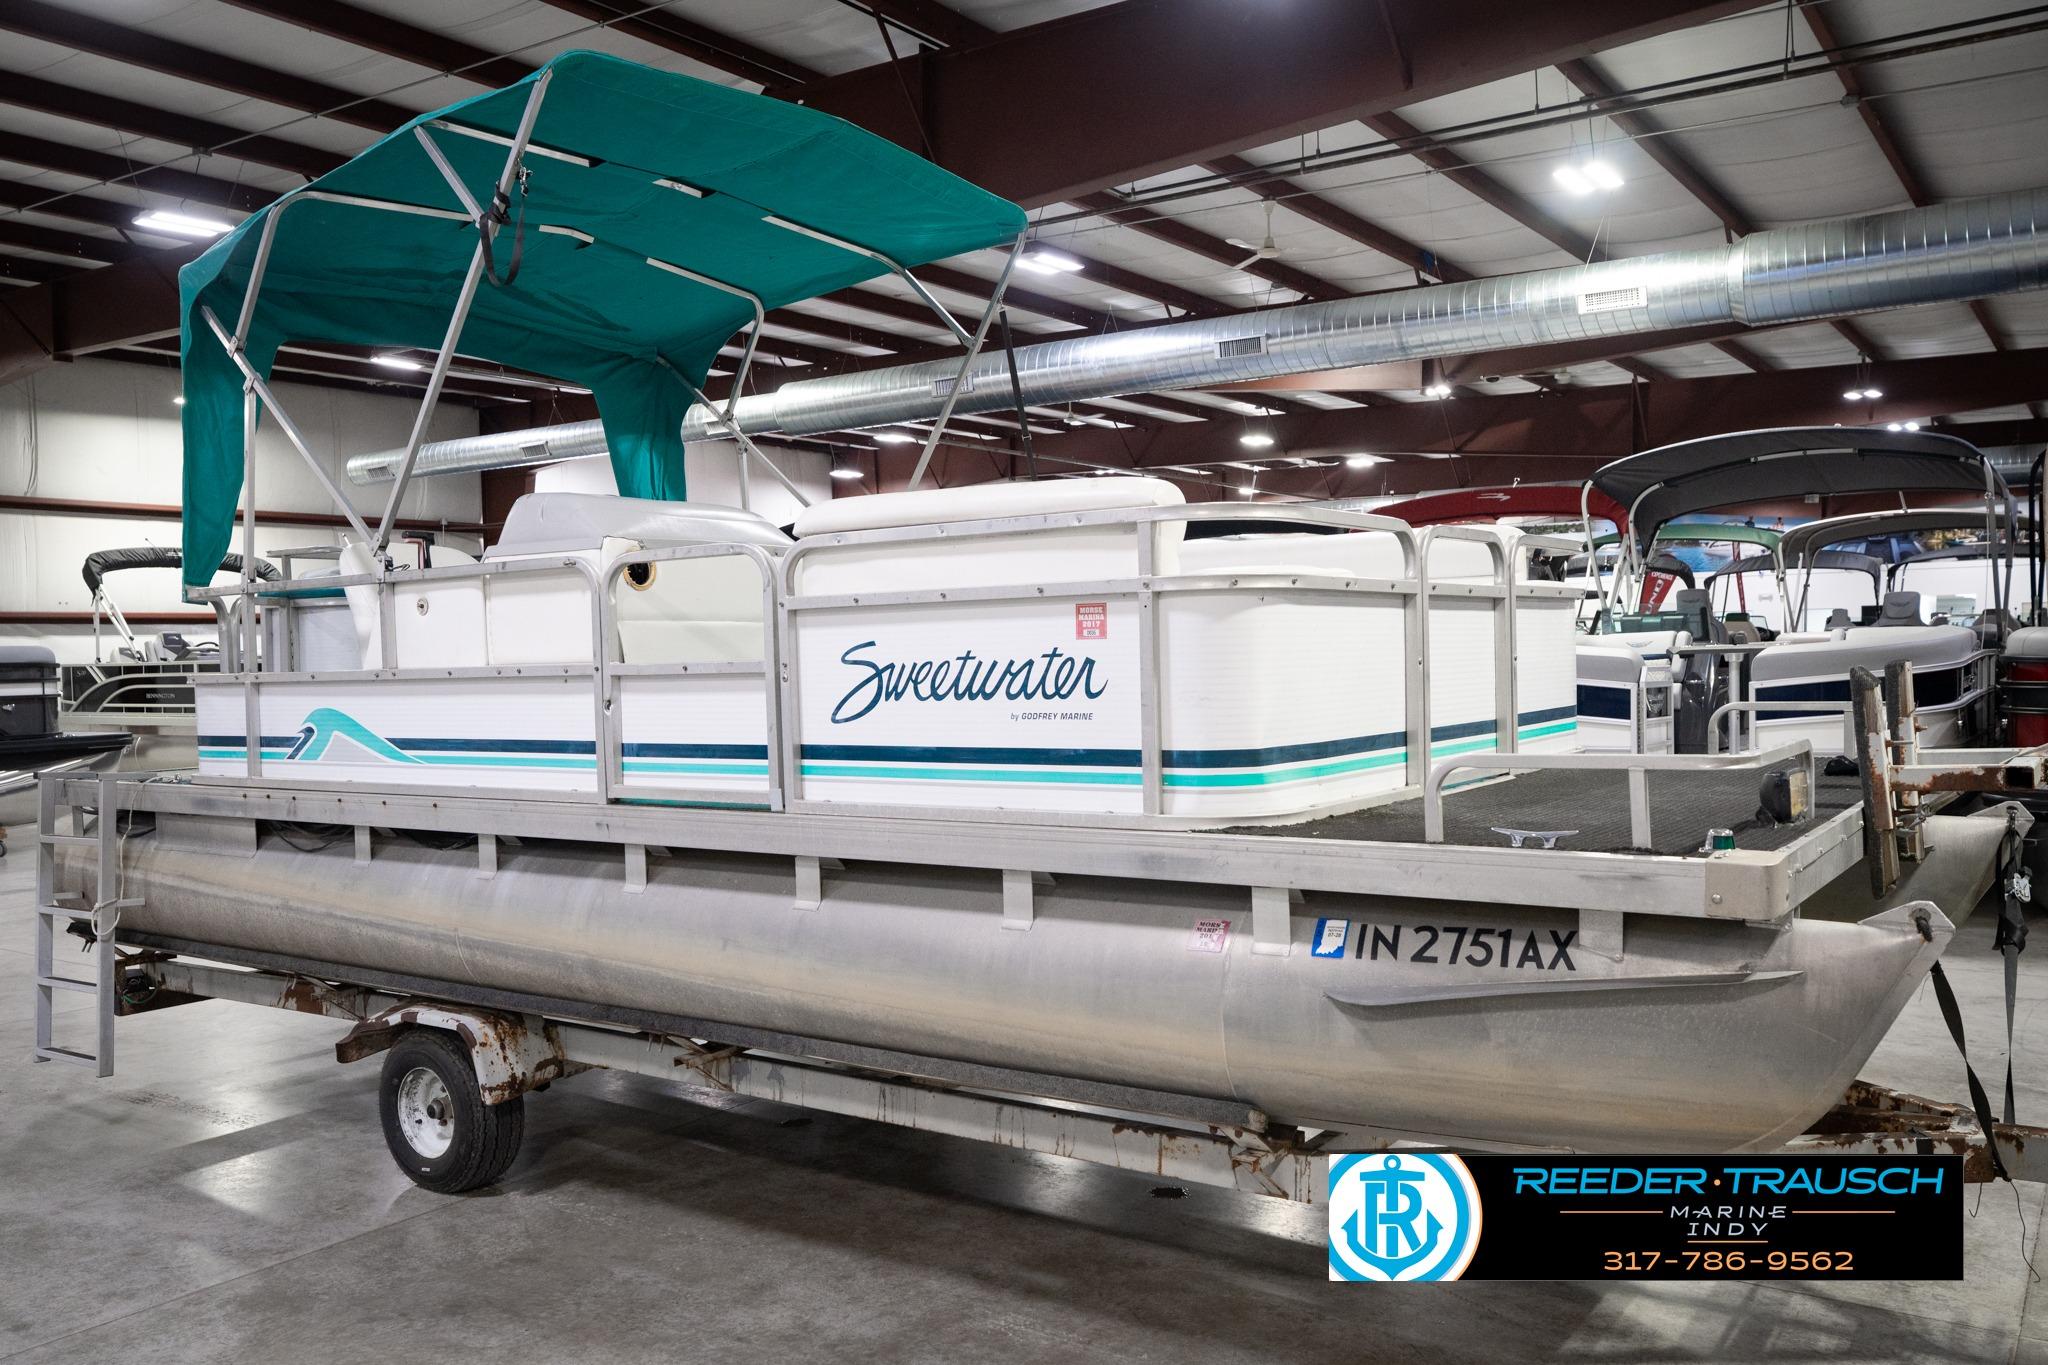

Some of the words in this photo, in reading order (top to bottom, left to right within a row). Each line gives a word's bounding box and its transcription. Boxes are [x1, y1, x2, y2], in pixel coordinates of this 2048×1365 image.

[1645, 579, 1665, 614] UND
[1079, 606, 1104, 614] MORSE
[1078, 613, 1105, 621] MARINA
[1082, 620, 1101, 628] 2017
[831, 640, 1109, 724] Sweetwater
[1010, 712, 1020, 722] by
[1021, 712, 1059, 720] GODFREY
[1060, 712, 1094, 720] MARINE
[1355, 924, 1401, 961] IN
[1410, 925, 1578, 971] 2751AX
